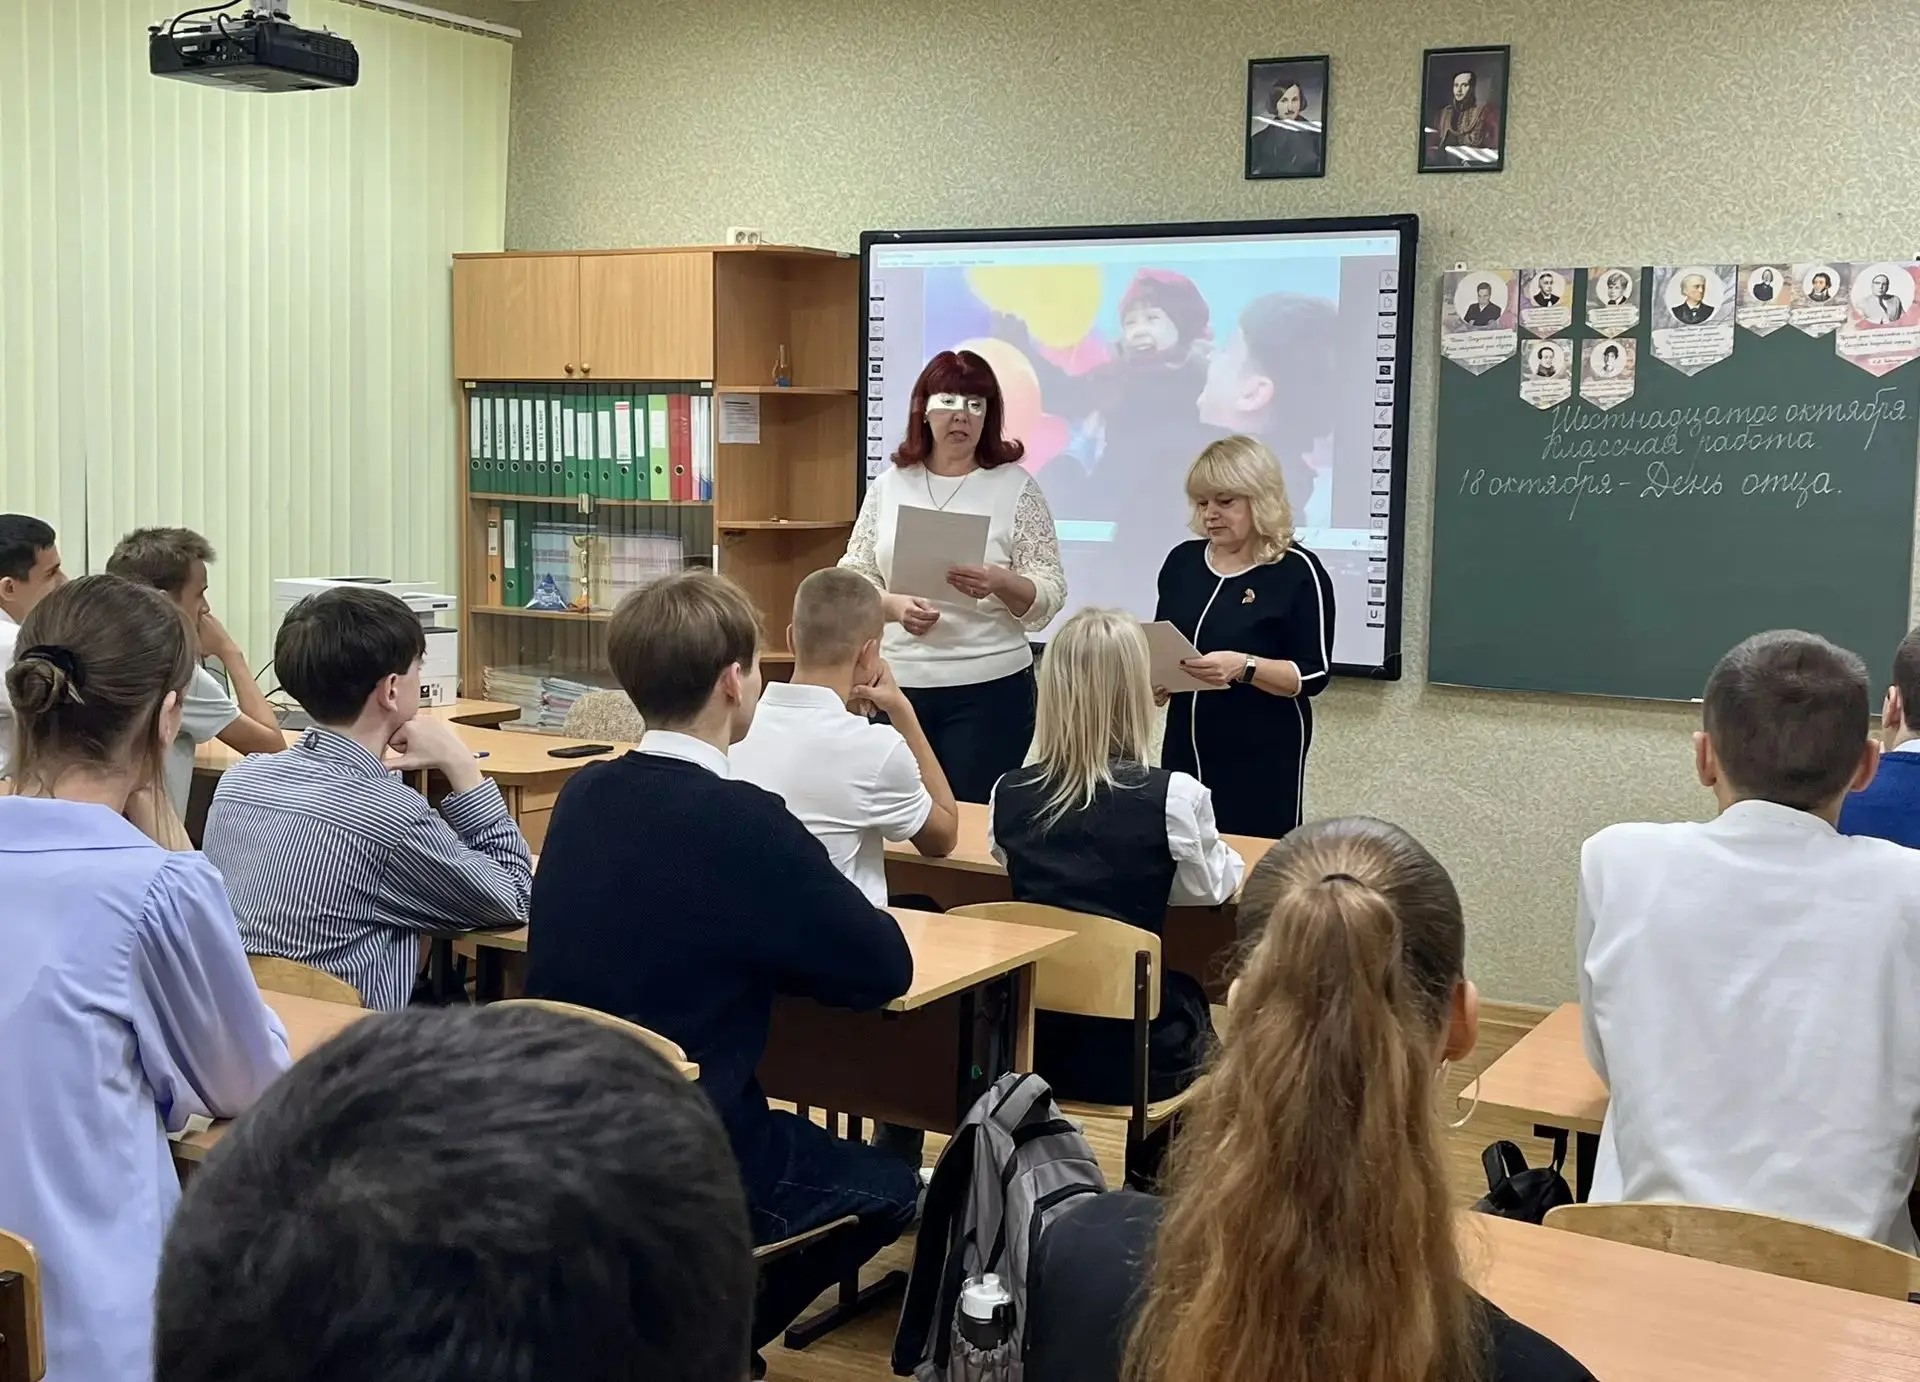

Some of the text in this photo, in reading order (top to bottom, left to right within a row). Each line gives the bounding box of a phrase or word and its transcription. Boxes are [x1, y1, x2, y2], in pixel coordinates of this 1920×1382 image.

[1551, 404, 1778, 437] Шестнадцатое
[1542, 430, 1684, 460] Классная
[1459, 468, 1486, 496] 18
[1639, 460, 1724, 498] День
[1741, 471, 1843, 509] отца.
